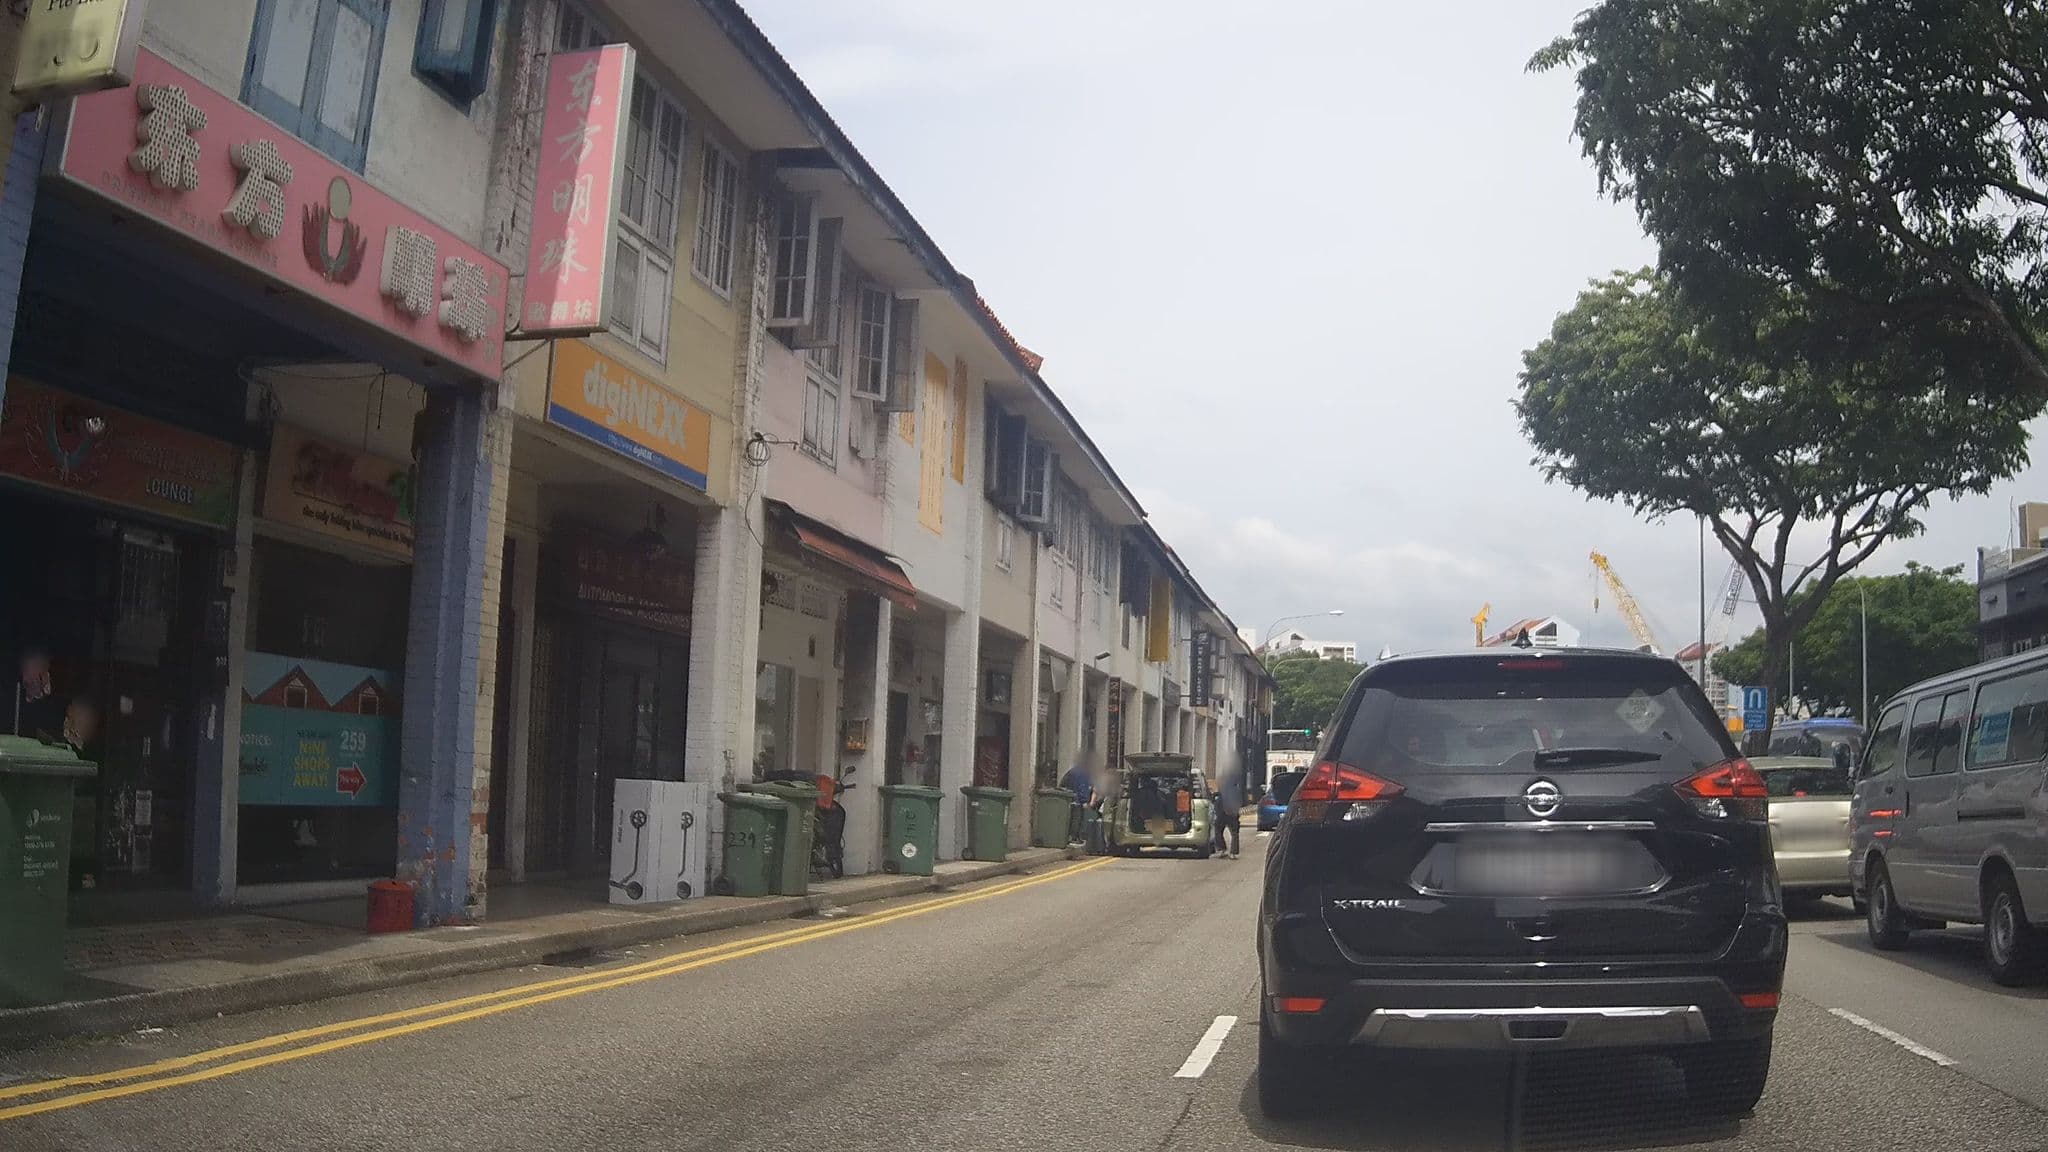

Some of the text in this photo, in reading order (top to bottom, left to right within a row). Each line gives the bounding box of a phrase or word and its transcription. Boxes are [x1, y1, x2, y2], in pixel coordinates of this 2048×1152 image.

[539, 60, 602, 285] 东方明珠
[146, 479, 194, 503] LOUNGE
[340, 729, 367, 751] 259
